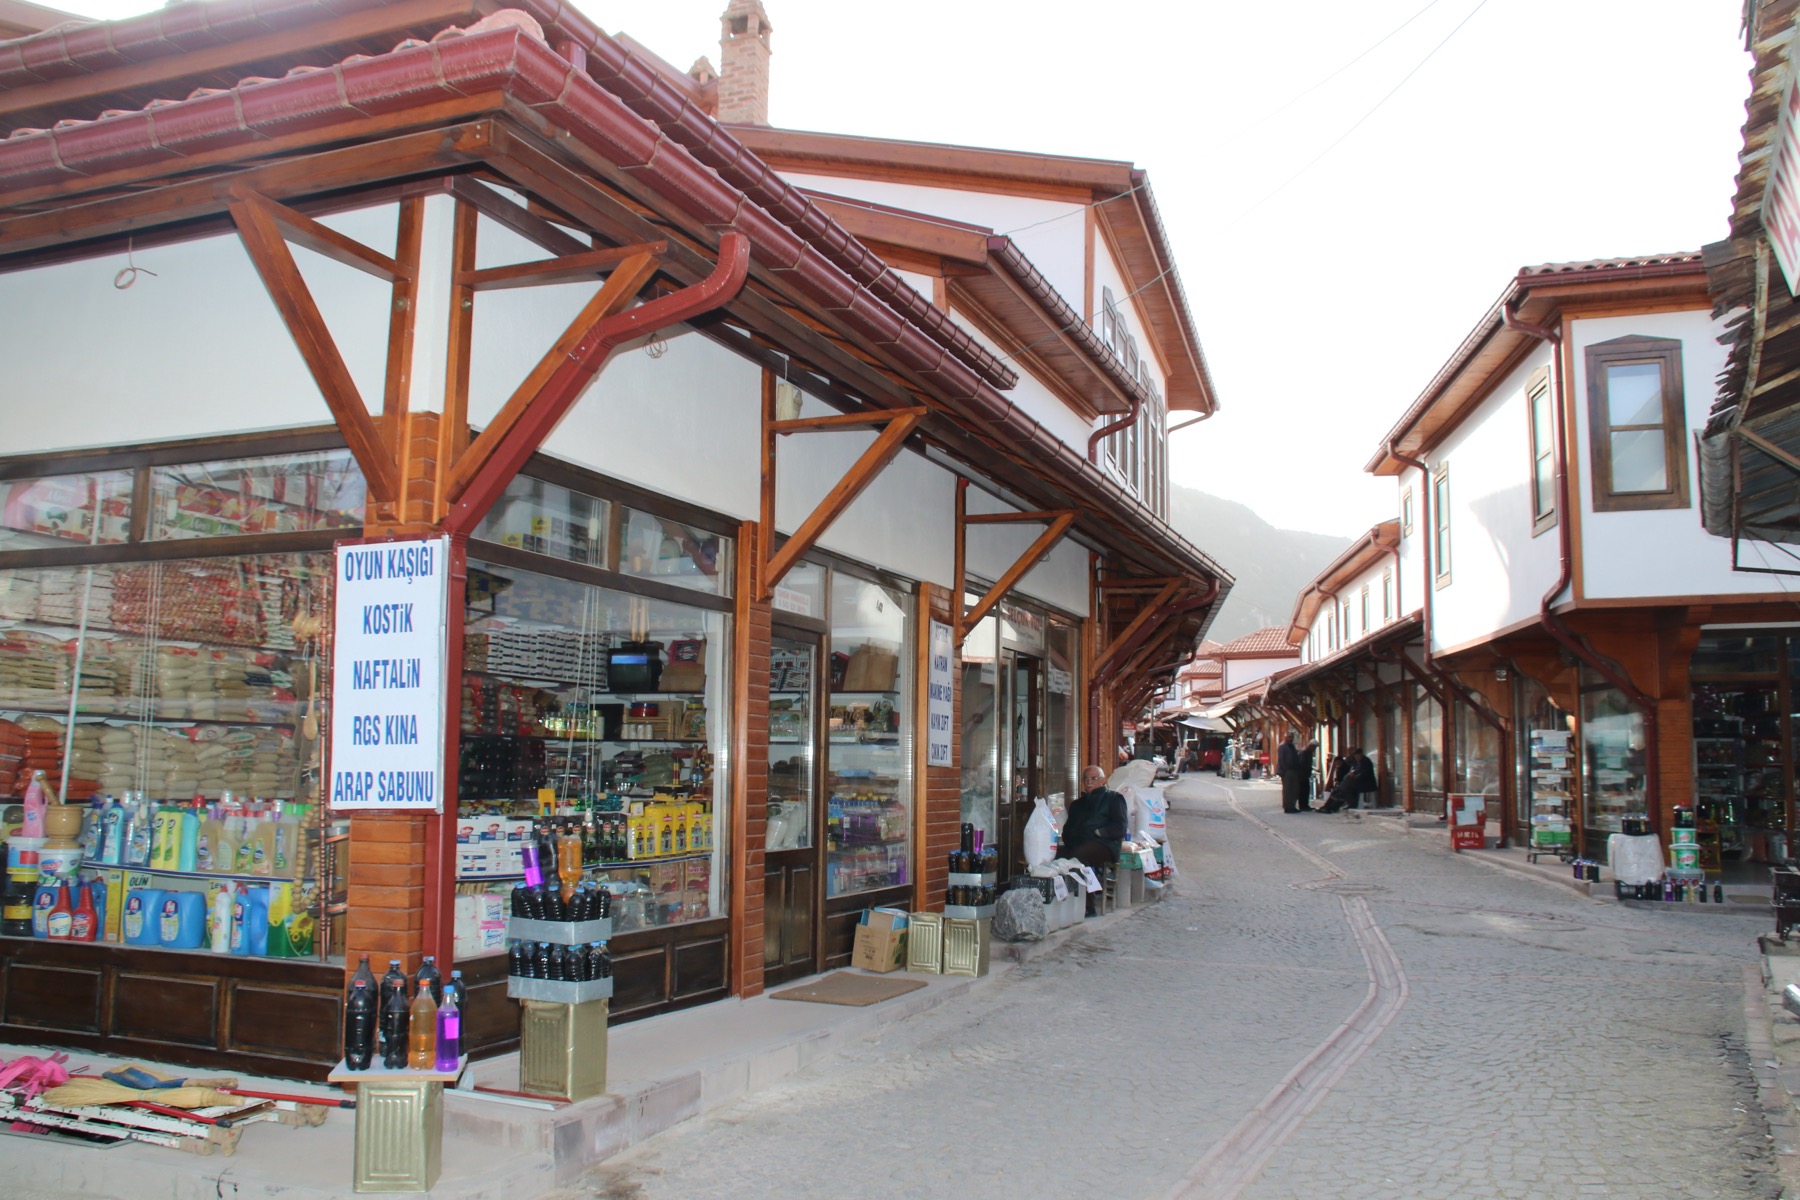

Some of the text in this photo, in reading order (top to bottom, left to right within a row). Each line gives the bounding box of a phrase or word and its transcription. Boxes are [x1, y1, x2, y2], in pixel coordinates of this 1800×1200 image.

[345, 540, 433, 584] OYUN KAŞIĞI
[353, 714, 418, 745] RGS KINA
[334, 771, 434, 802] ARAP SABUNU
[129, 874, 149, 886] OLİN
